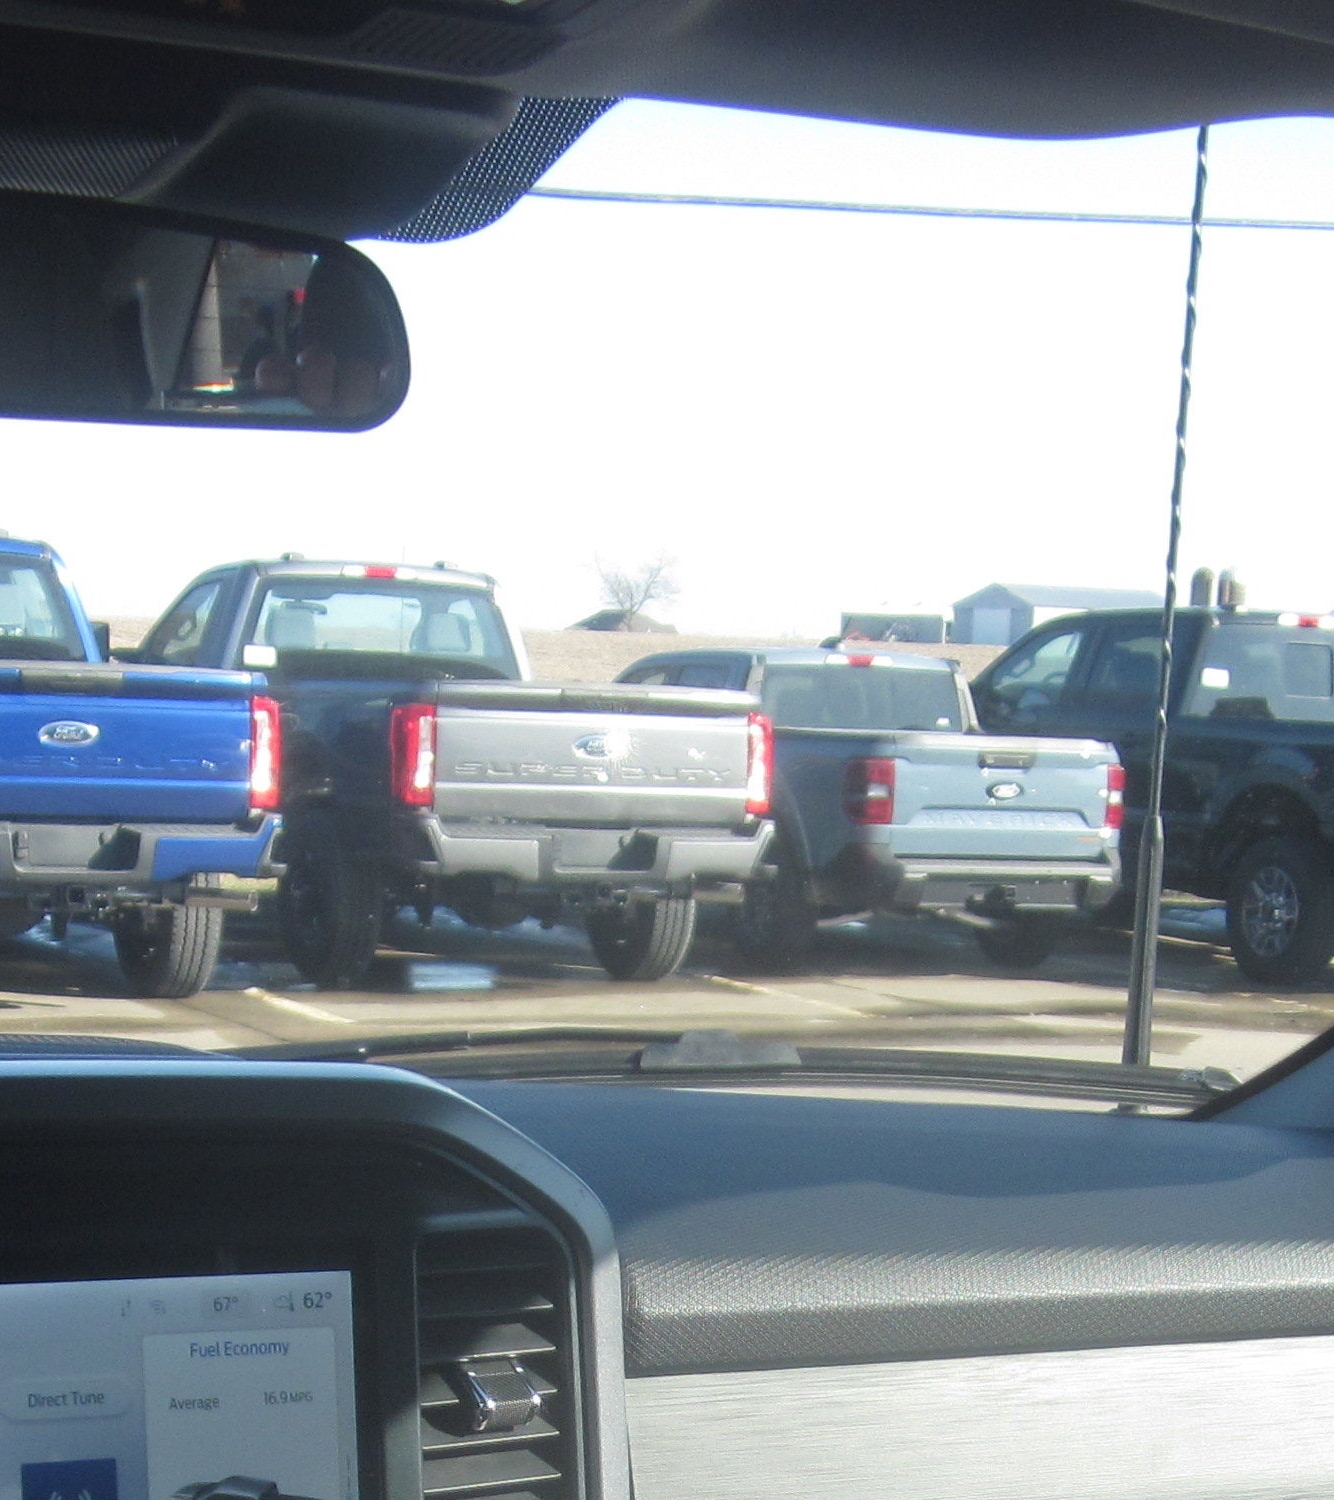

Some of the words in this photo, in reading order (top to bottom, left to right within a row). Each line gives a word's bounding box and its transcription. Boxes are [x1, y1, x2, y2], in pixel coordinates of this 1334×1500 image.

[455, 762, 608, 782] SUPER
[302, 1291, 333, 1309] 62°
[189, 1341, 221, 1358] Fuel
[224, 1340, 290, 1358] Economy
[27, 1391, 67, 1408] Direct
[71, 1390, 105, 1406] Tune
[169, 1396, 220, 1412] Average
